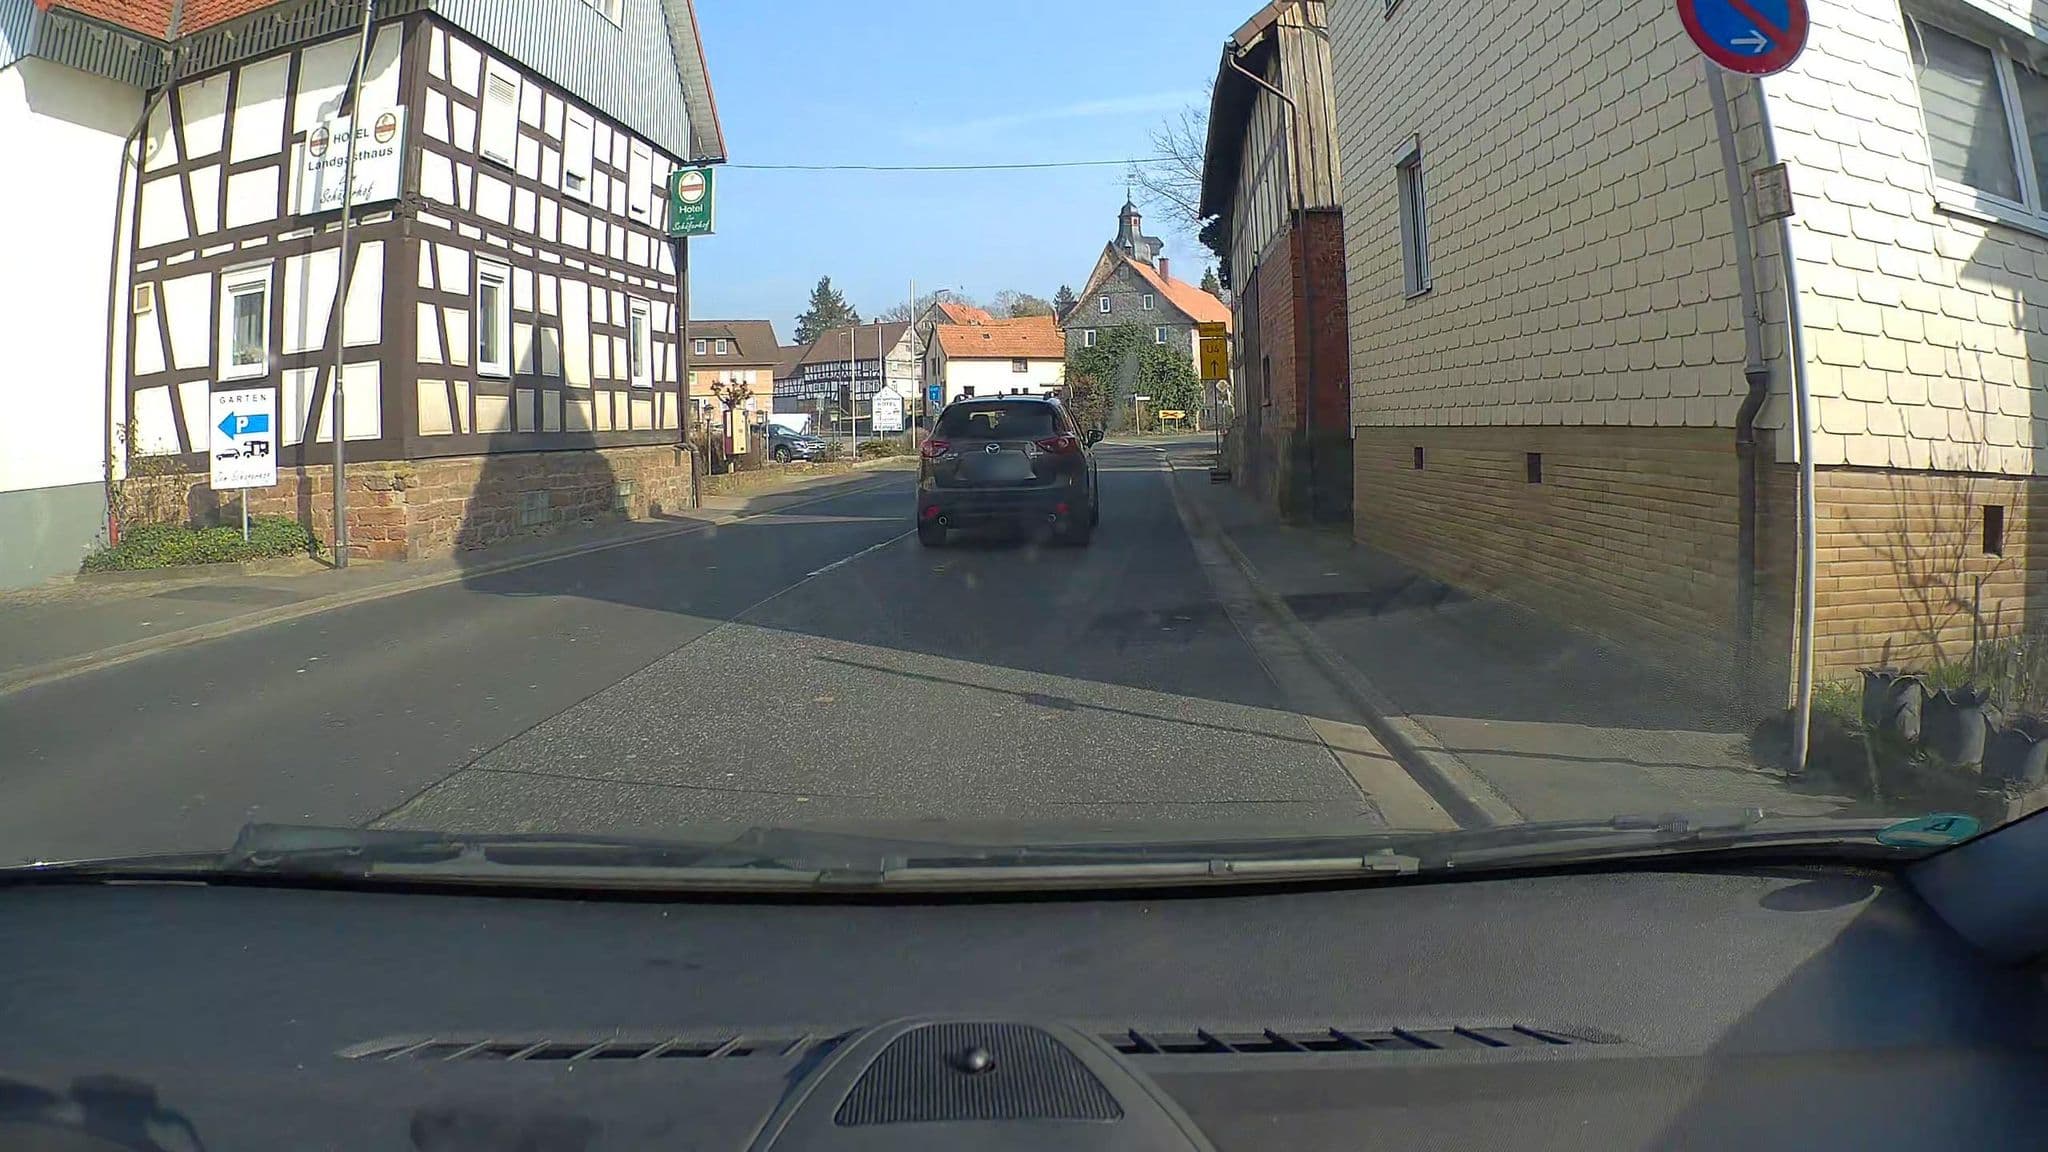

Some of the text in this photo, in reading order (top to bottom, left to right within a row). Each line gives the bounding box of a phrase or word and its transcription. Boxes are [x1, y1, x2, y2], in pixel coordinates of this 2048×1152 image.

[333, 128, 369, 144] HOEL
[320, 180, 374, 205] Schärhof
[679, 204, 703, 214] Hotel
[219, 394, 267, 405] GARTEN
[236, 416, 249, 434] P
